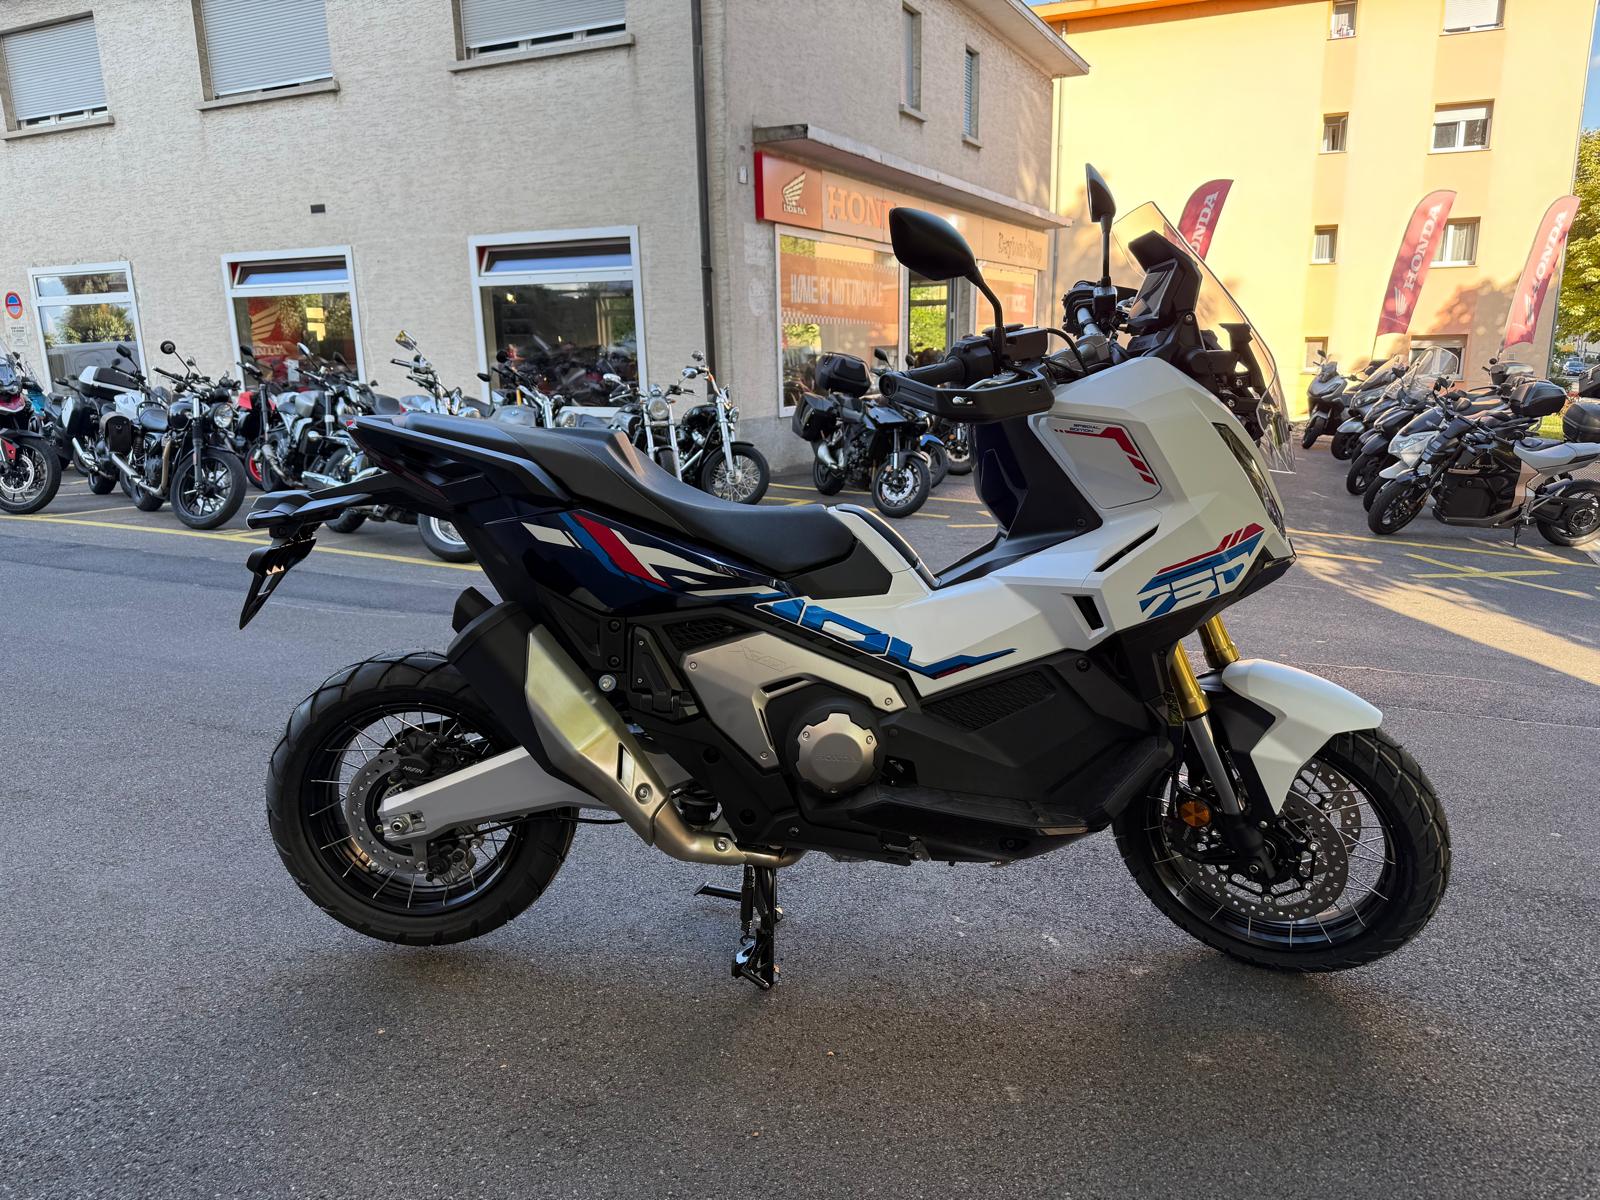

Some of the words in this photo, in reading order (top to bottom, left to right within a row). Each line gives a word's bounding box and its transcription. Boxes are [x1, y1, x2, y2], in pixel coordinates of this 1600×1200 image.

[783, 203, 808, 216] HONDA
[827, 185, 896, 229] HON
[1190, 191, 1220, 253] ONDA
[1403, 203, 1443, 291] HONDA
